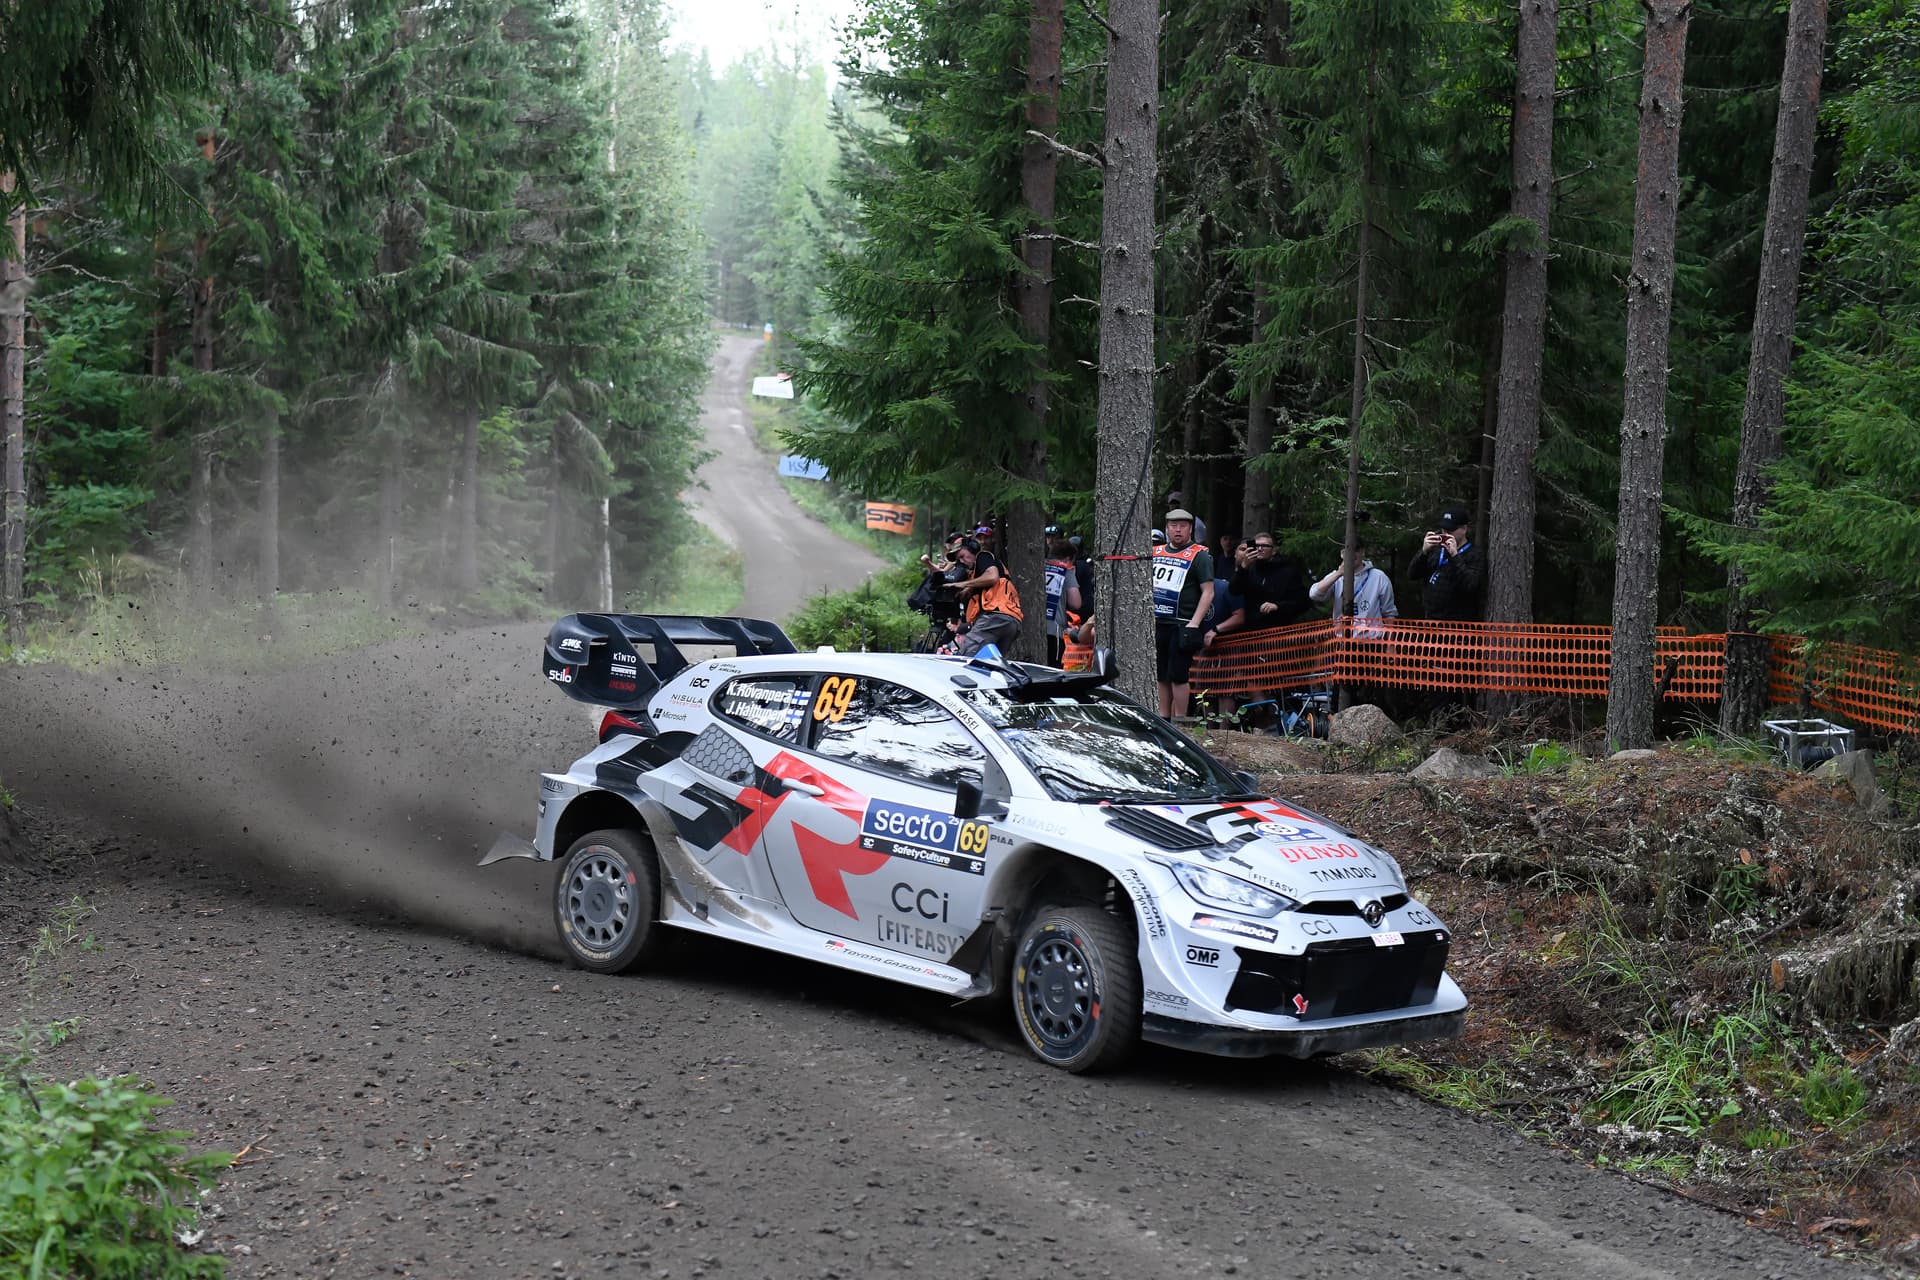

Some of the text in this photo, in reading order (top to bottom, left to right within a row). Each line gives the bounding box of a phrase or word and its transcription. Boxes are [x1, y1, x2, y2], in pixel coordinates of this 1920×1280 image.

[548, 666, 572, 683] Stilo
[671, 693, 703, 704] NISULA
[813, 675, 856, 723] 69
[662, 710, 687, 721] Microsoft
[873, 809, 947, 844] secto
[959, 821, 989, 855] 69
[989, 834, 1014, 846] PIAA
[1279, 842, 1359, 864] DENSO
[1309, 866, 1377, 883] TAMADIC
[1126, 868, 1166, 938] Panasonic
[843, 948, 882, 962] TOYOTA
[883, 959, 921, 973] GAZOO
[1186, 949, 1220, 965] OMP
